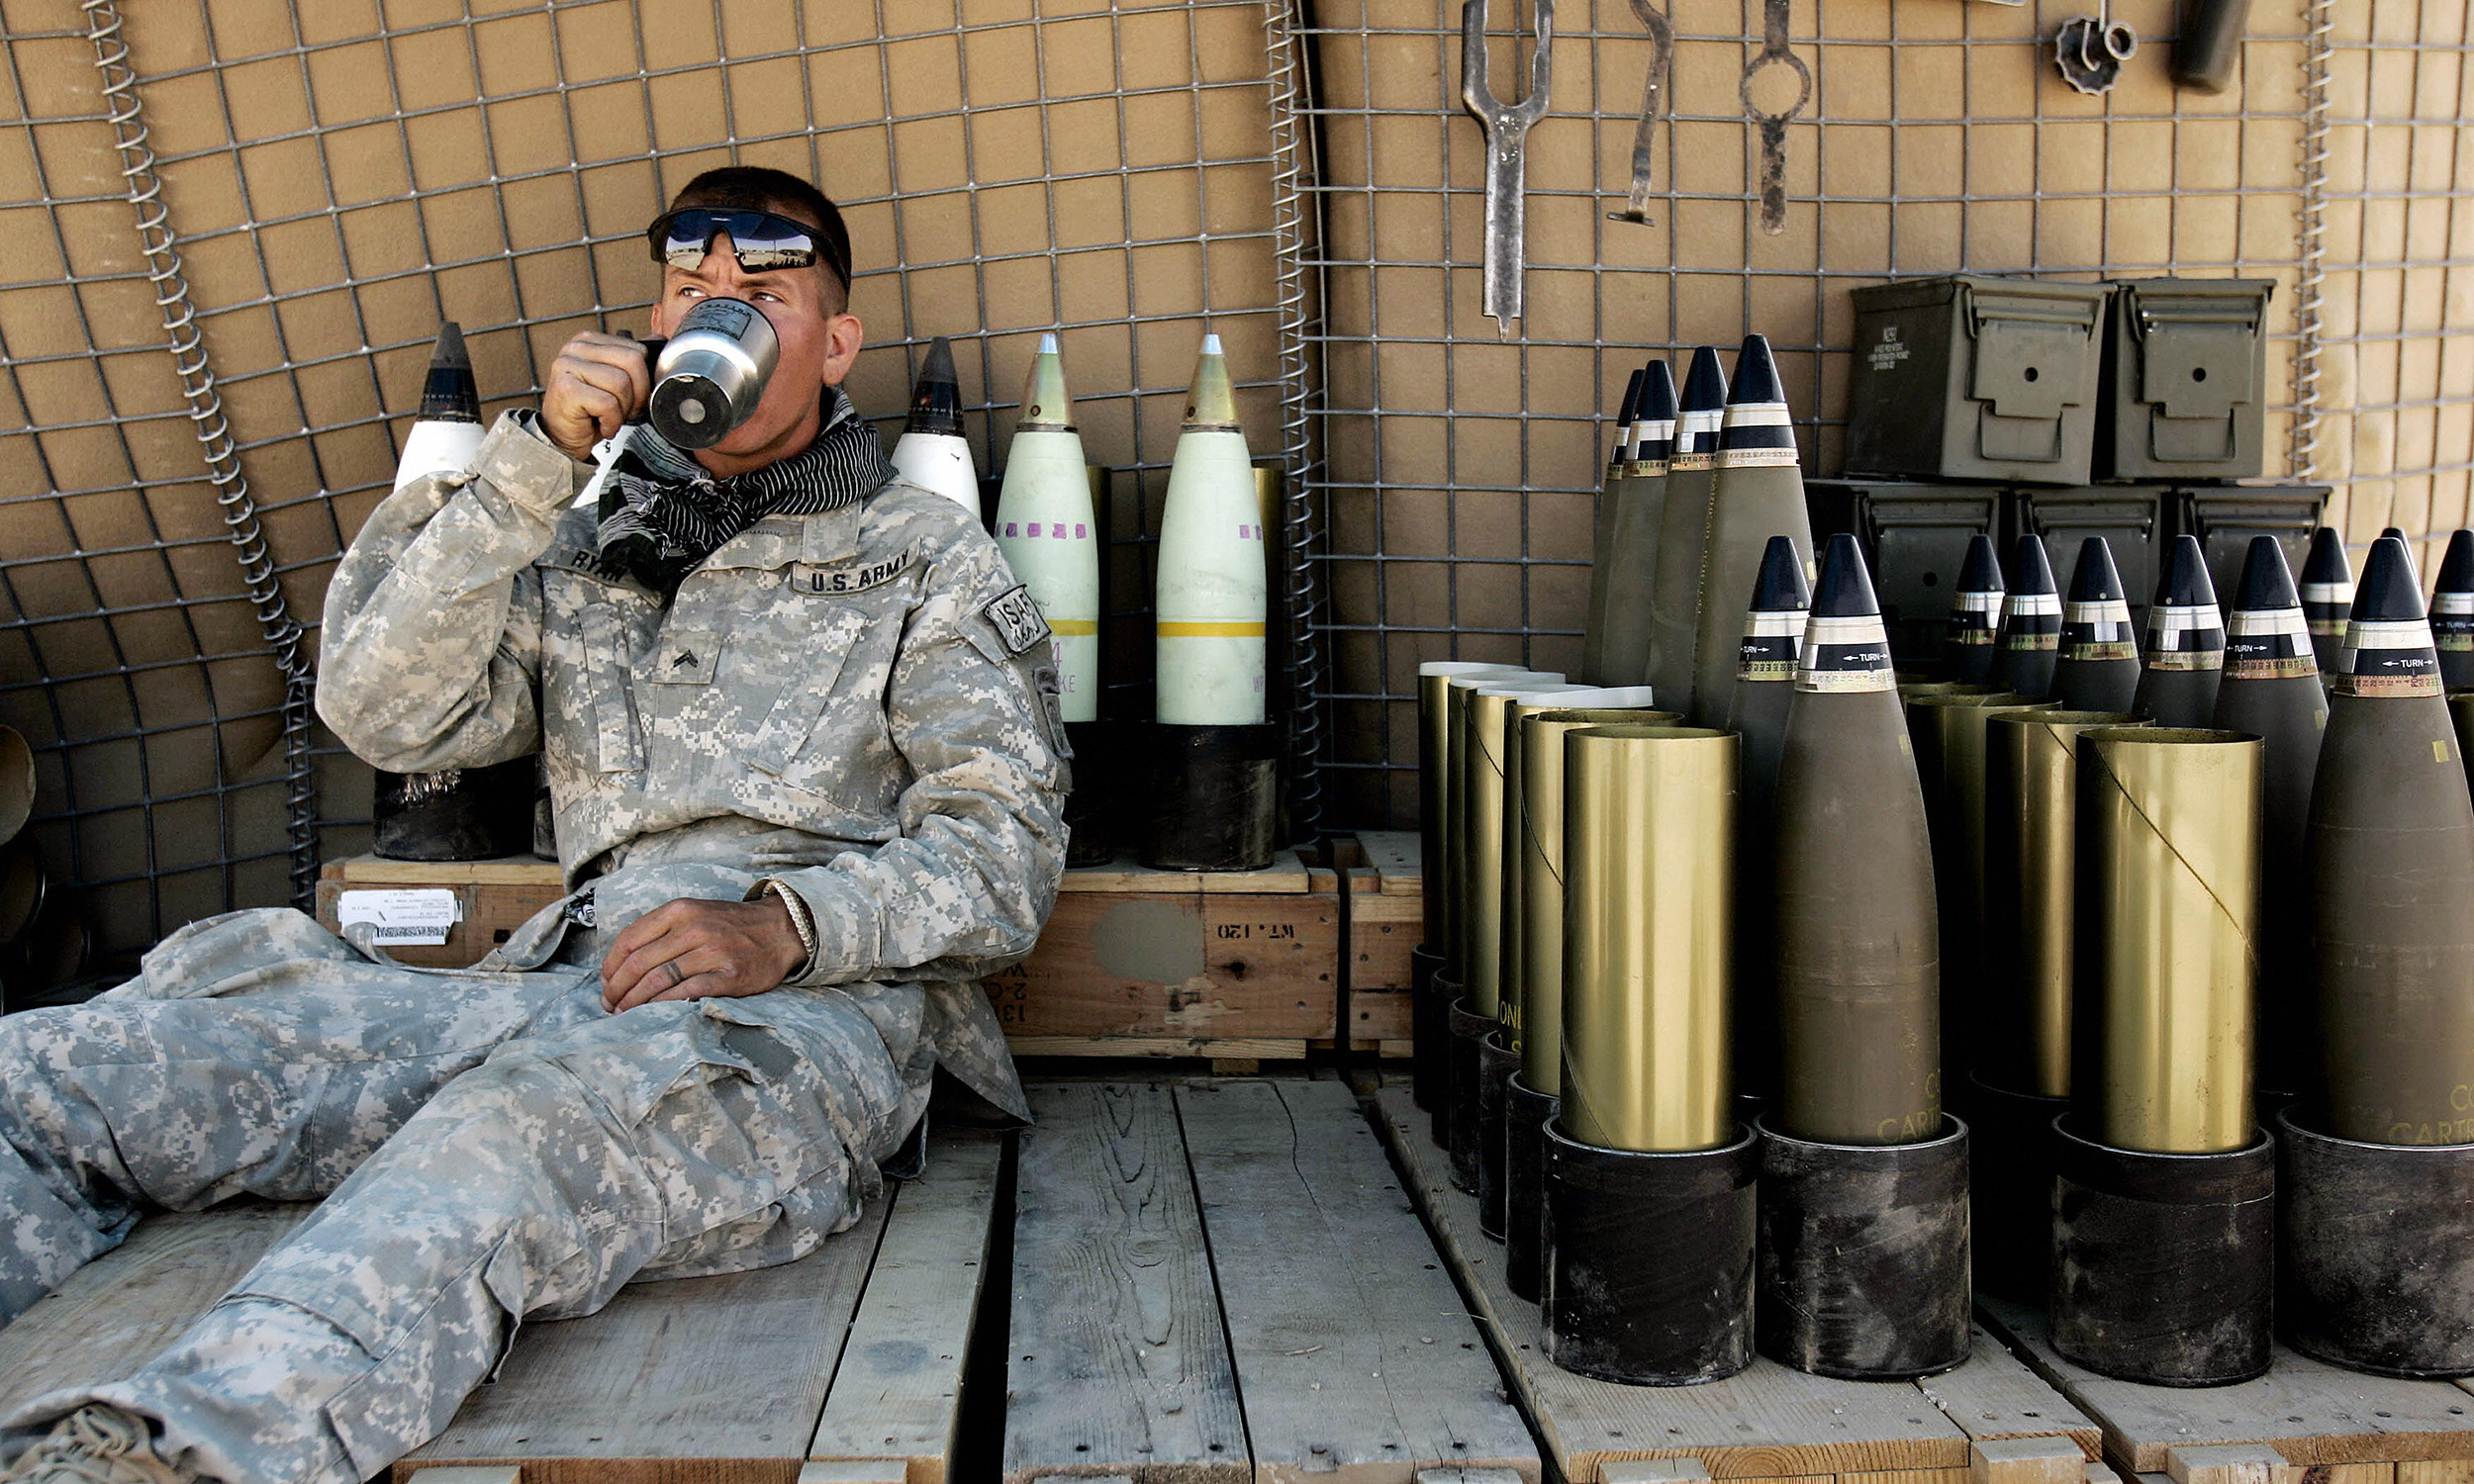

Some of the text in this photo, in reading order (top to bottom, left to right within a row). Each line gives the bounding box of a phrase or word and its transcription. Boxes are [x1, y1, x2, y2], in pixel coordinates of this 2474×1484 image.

[811, 548, 909, 592] U.S. ARMY
[2234, 644, 2253, 653] TURN
[1858, 653, 1881, 662] TURN
[2400, 659, 2425, 668] TURN
